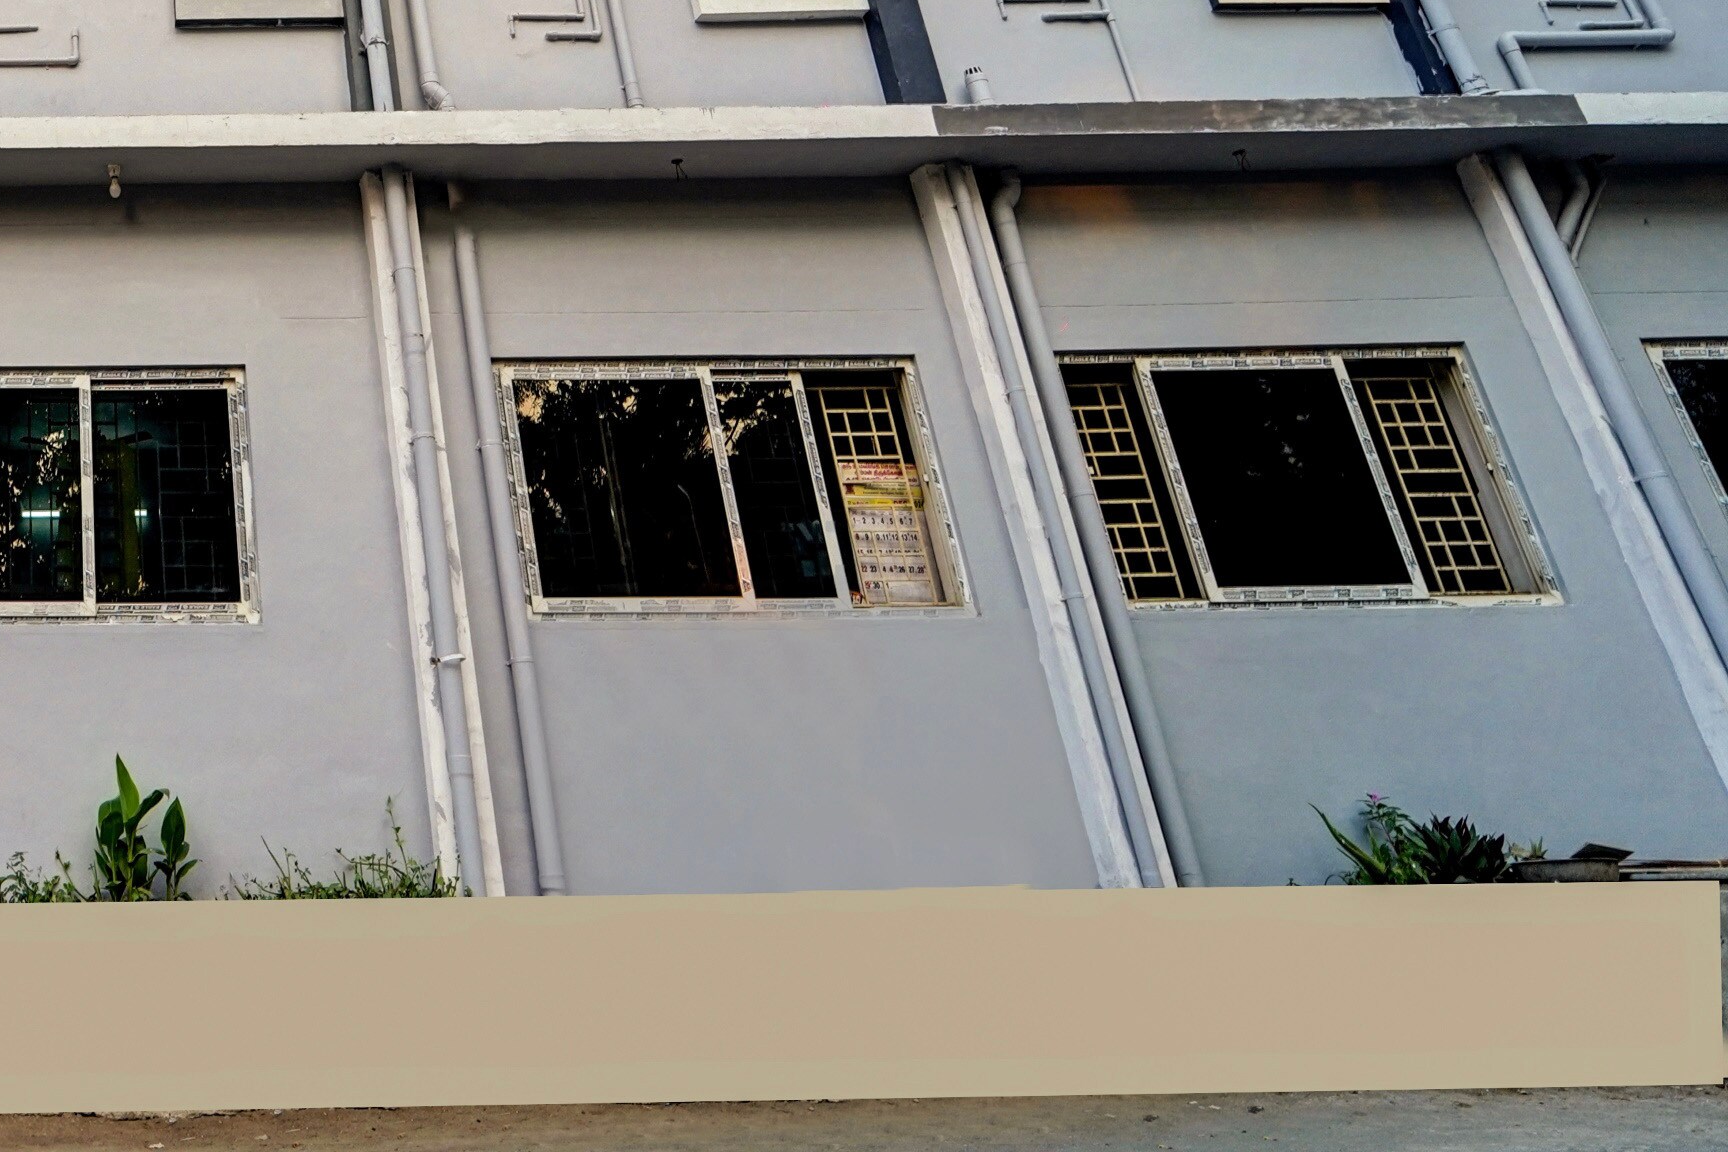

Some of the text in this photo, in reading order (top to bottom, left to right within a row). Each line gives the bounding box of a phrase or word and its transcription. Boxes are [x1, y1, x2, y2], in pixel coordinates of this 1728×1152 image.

[900, 517, 903, 525] 6
[909, 517, 912, 525] 7
[901, 533, 907, 541] 13
